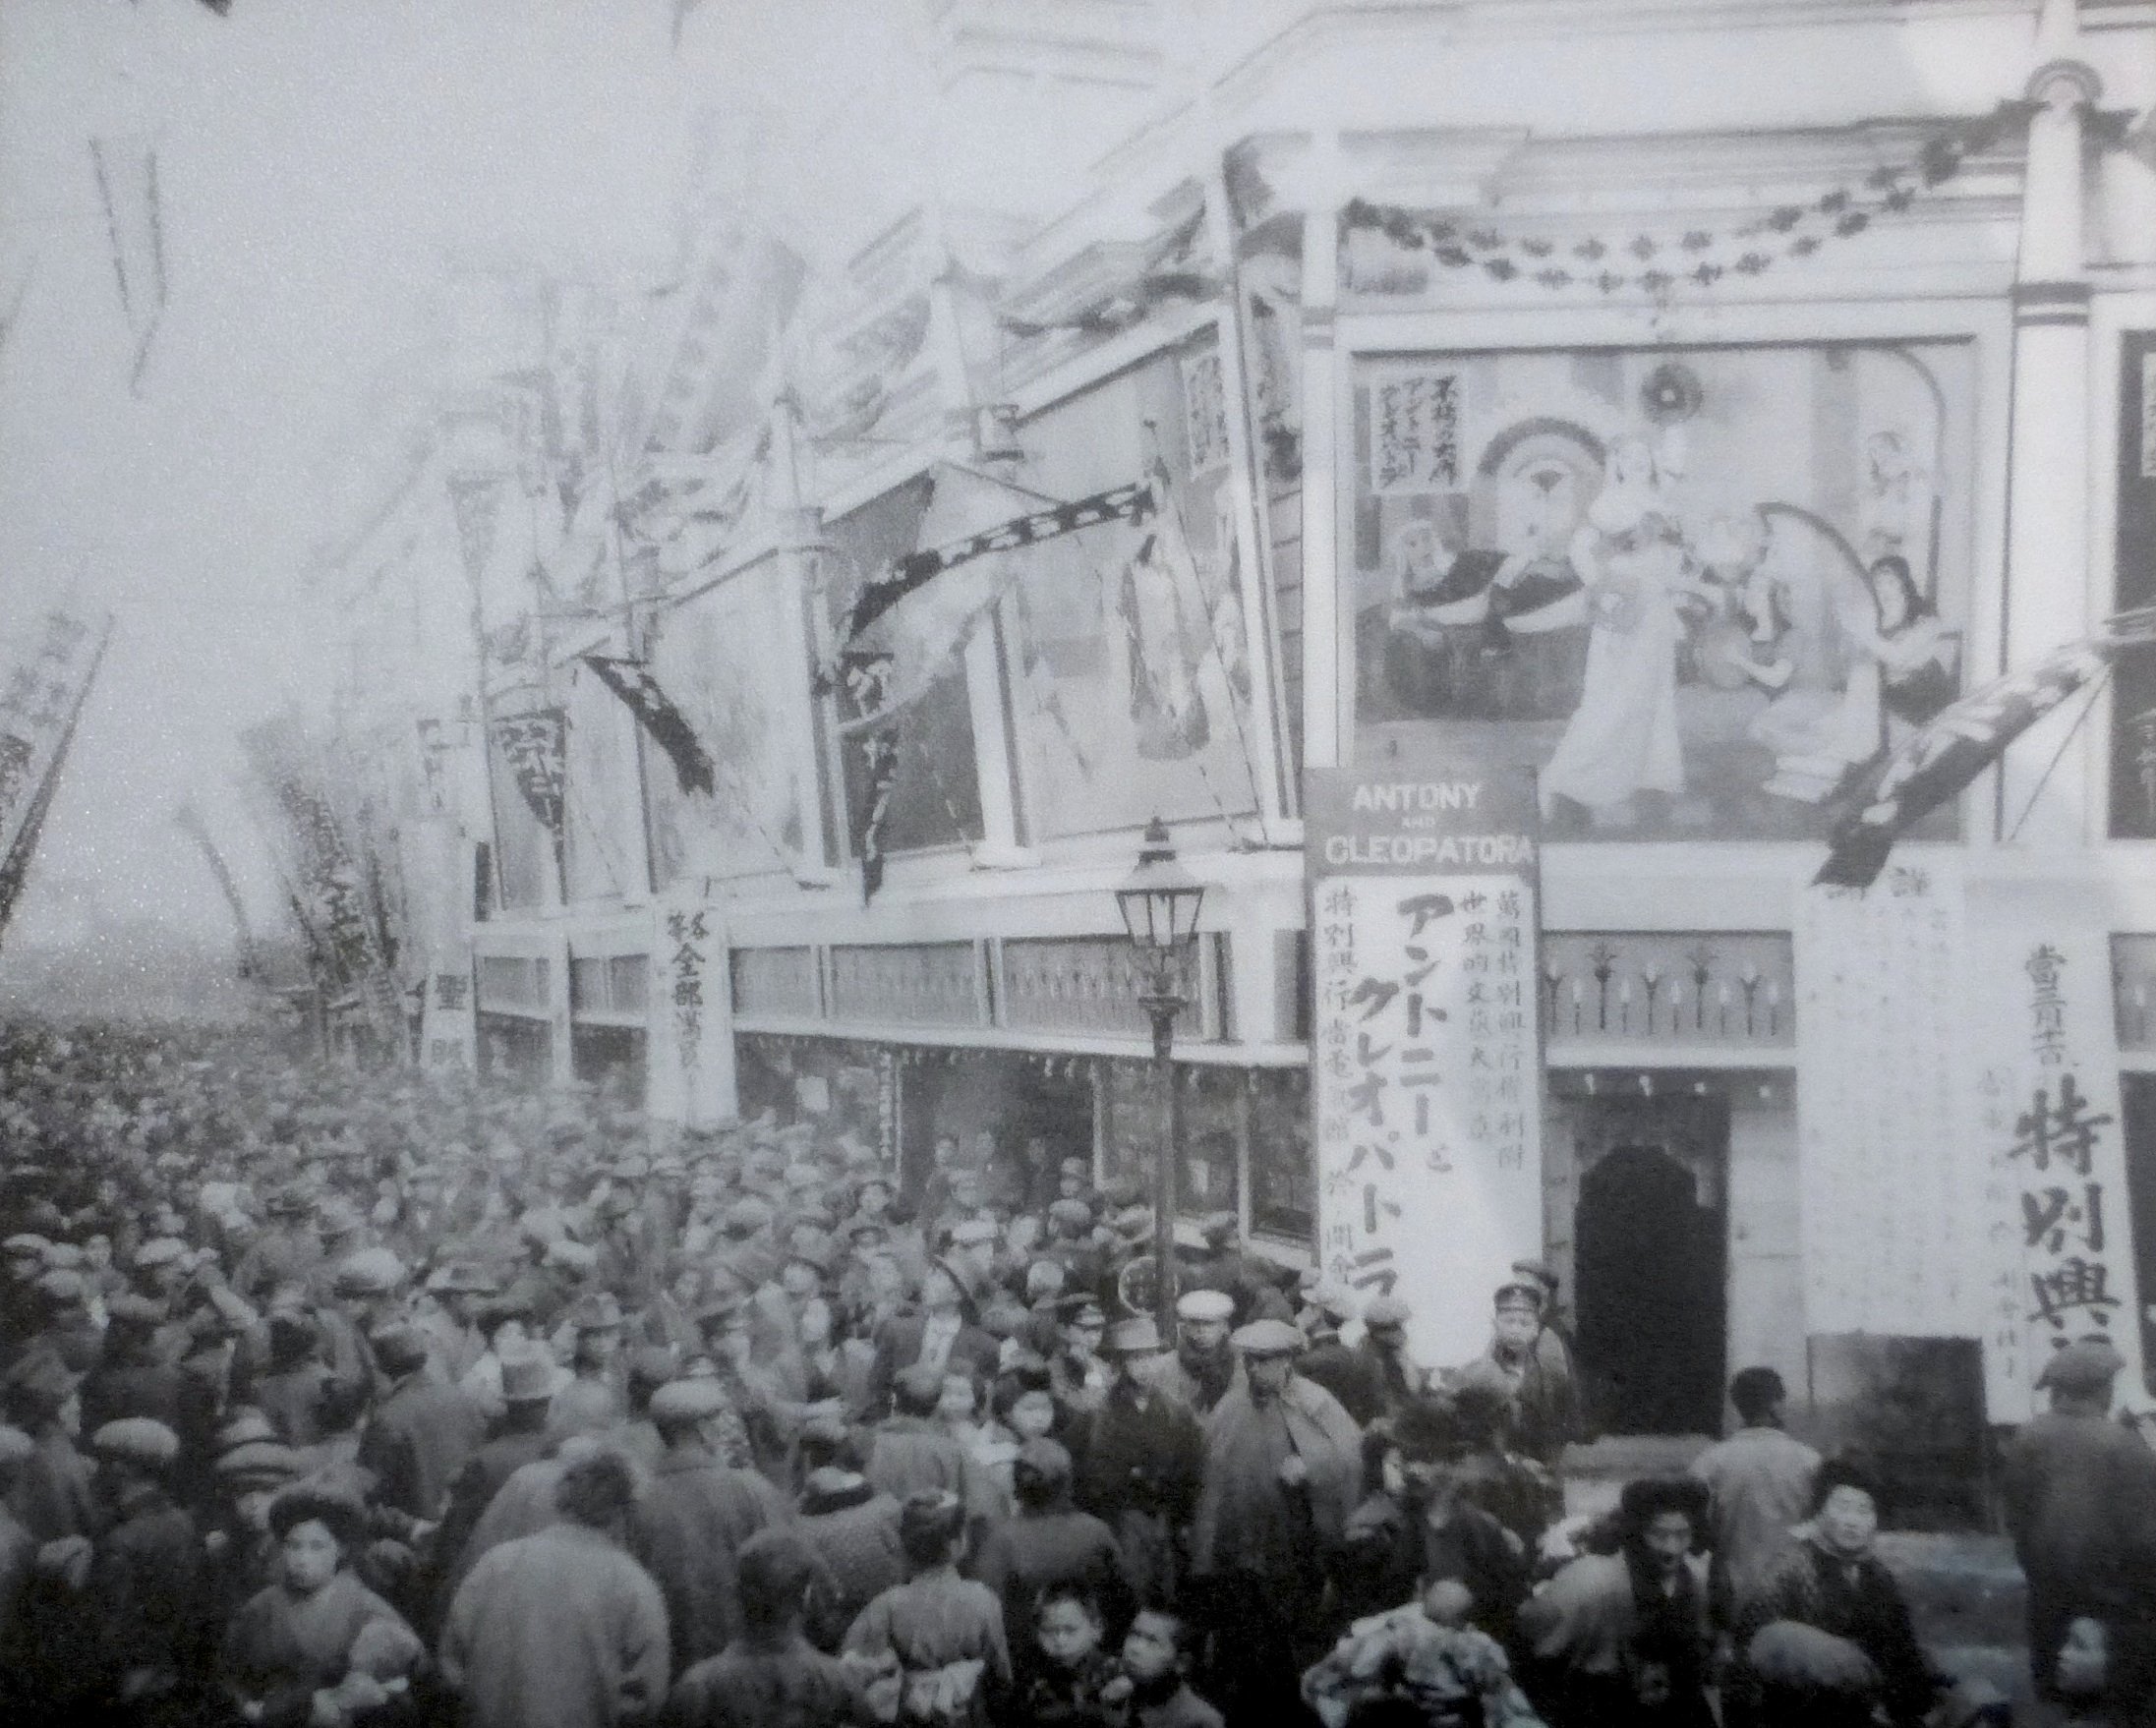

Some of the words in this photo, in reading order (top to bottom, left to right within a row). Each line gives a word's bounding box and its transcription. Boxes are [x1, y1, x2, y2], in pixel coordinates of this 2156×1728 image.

[1326, 835, 1535, 865] CLEOPATORA
[1352, 782, 1481, 812] ANTONY
[1347, 977, 1403, 1297] クレオパトラ
[1396, 893, 1455, 1173] アントニーと
[2007, 1071, 2121, 1348] 特別興
